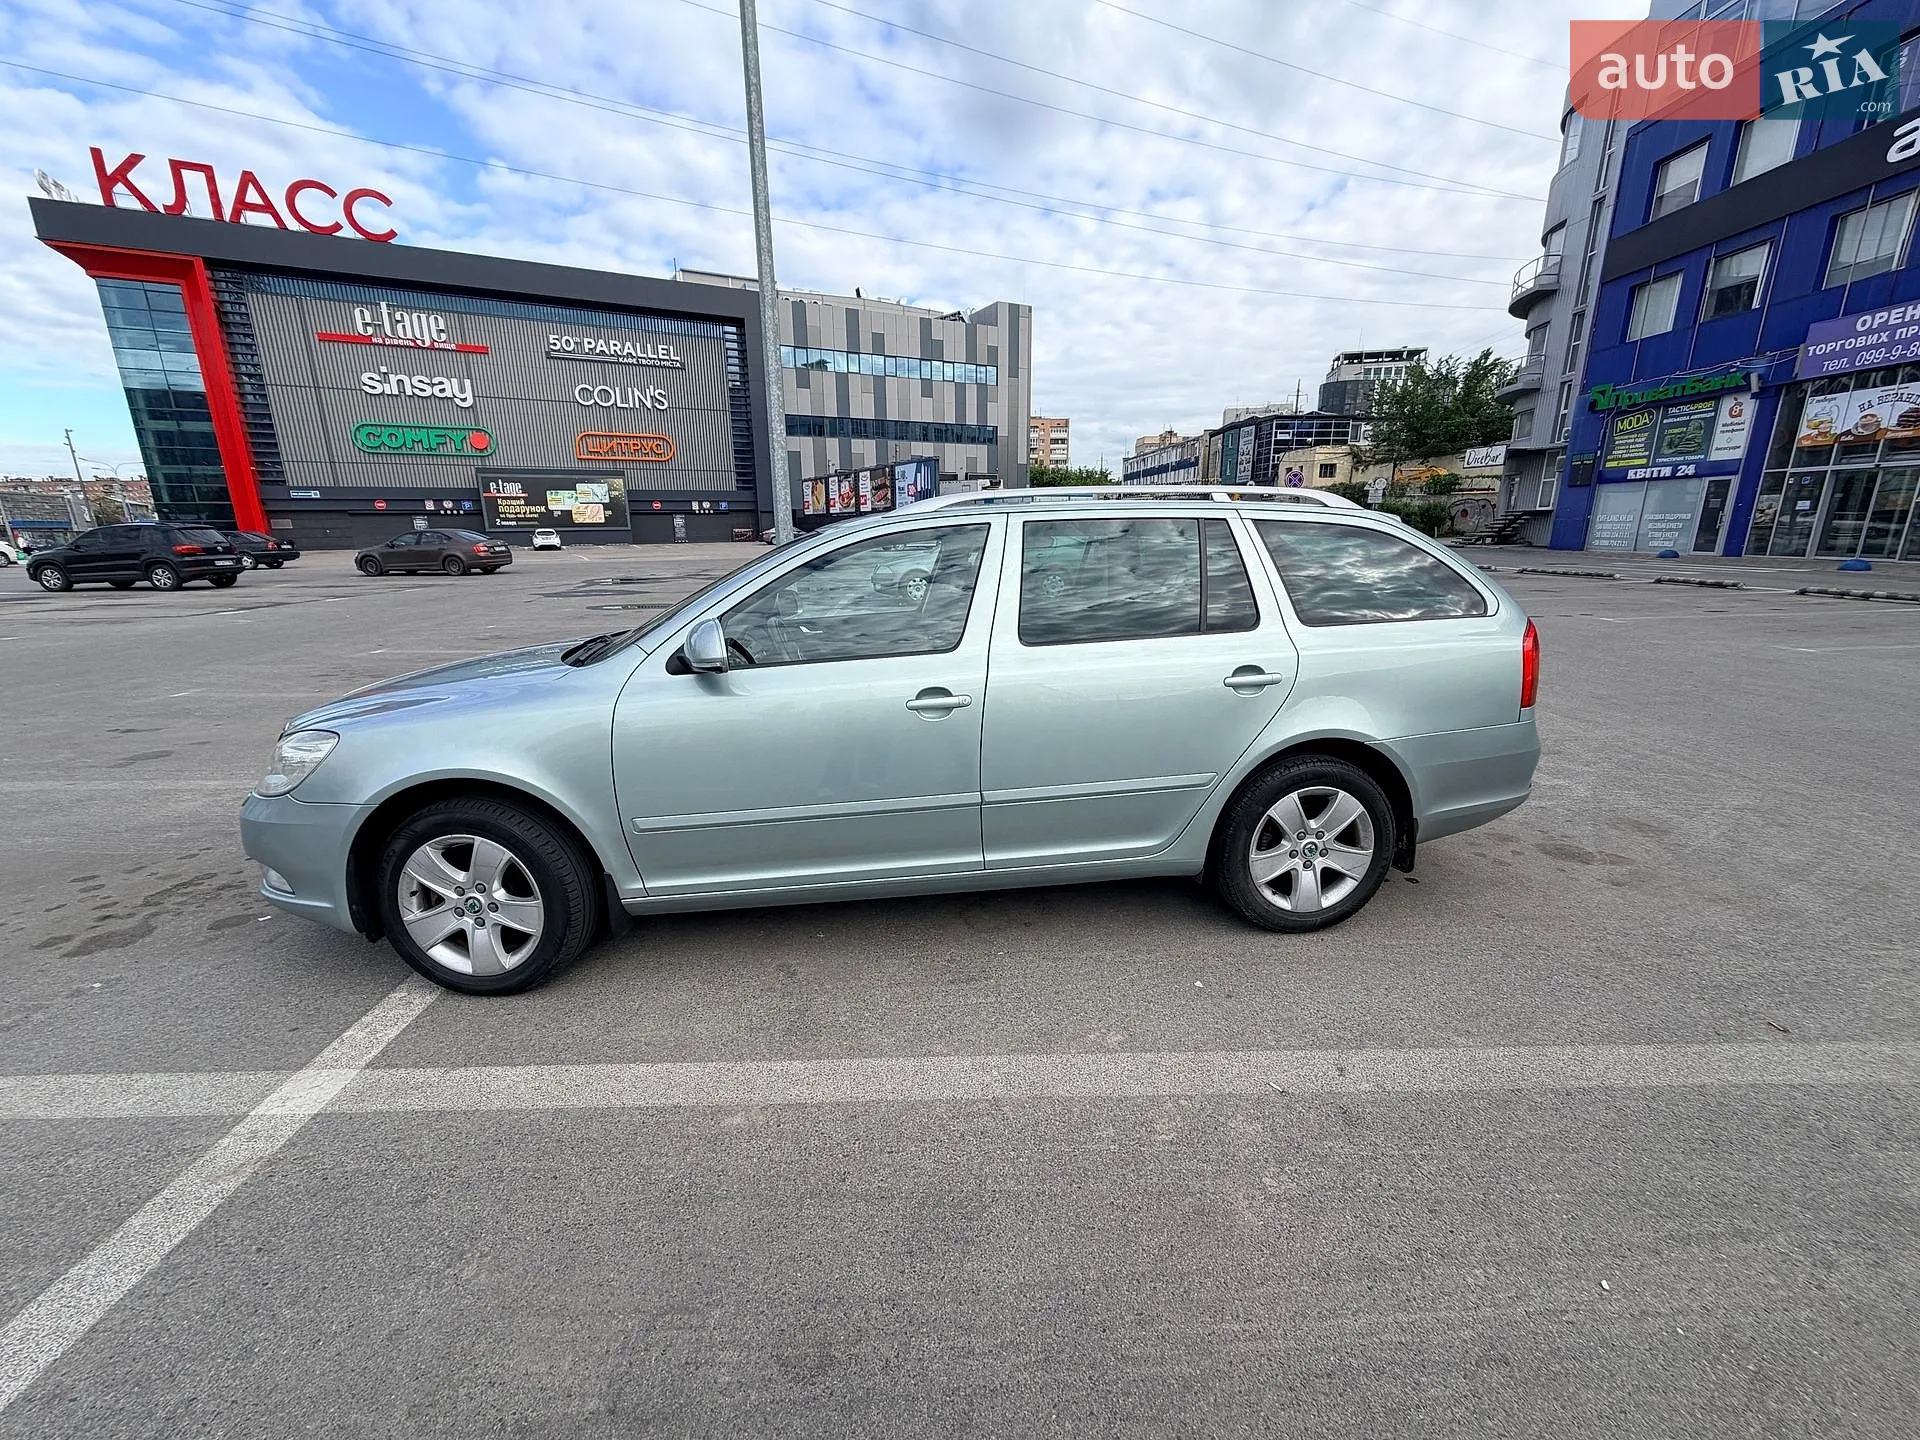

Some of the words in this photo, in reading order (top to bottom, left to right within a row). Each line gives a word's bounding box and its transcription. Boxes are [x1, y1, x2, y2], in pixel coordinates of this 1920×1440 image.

[89, 146, 398, 243] КЛАСС
[354, 301, 448, 348] e-tage
[583, 337, 681, 361] PARALLEL
[1807, 330, 1890, 357] ТОРГОВИХ
[638, 358, 661, 367] ТВОГО
[661, 360, 681, 368] МІСТА
[1822, 356, 1850, 372] тел.
[361, 365, 474, 408] sinsay
[574, 383, 669, 410] COLIN'S
[1616, 411, 1650, 433] MODA
[359, 427, 466, 450] COMFY
[586, 439, 665, 455] ЦИТРУС
[1627, 465, 1673, 480] КВІТИ
[1675, 464, 1697, 477] 24
[497, 498, 525, 506] Кращий
[498, 505, 547, 514] подарунок
